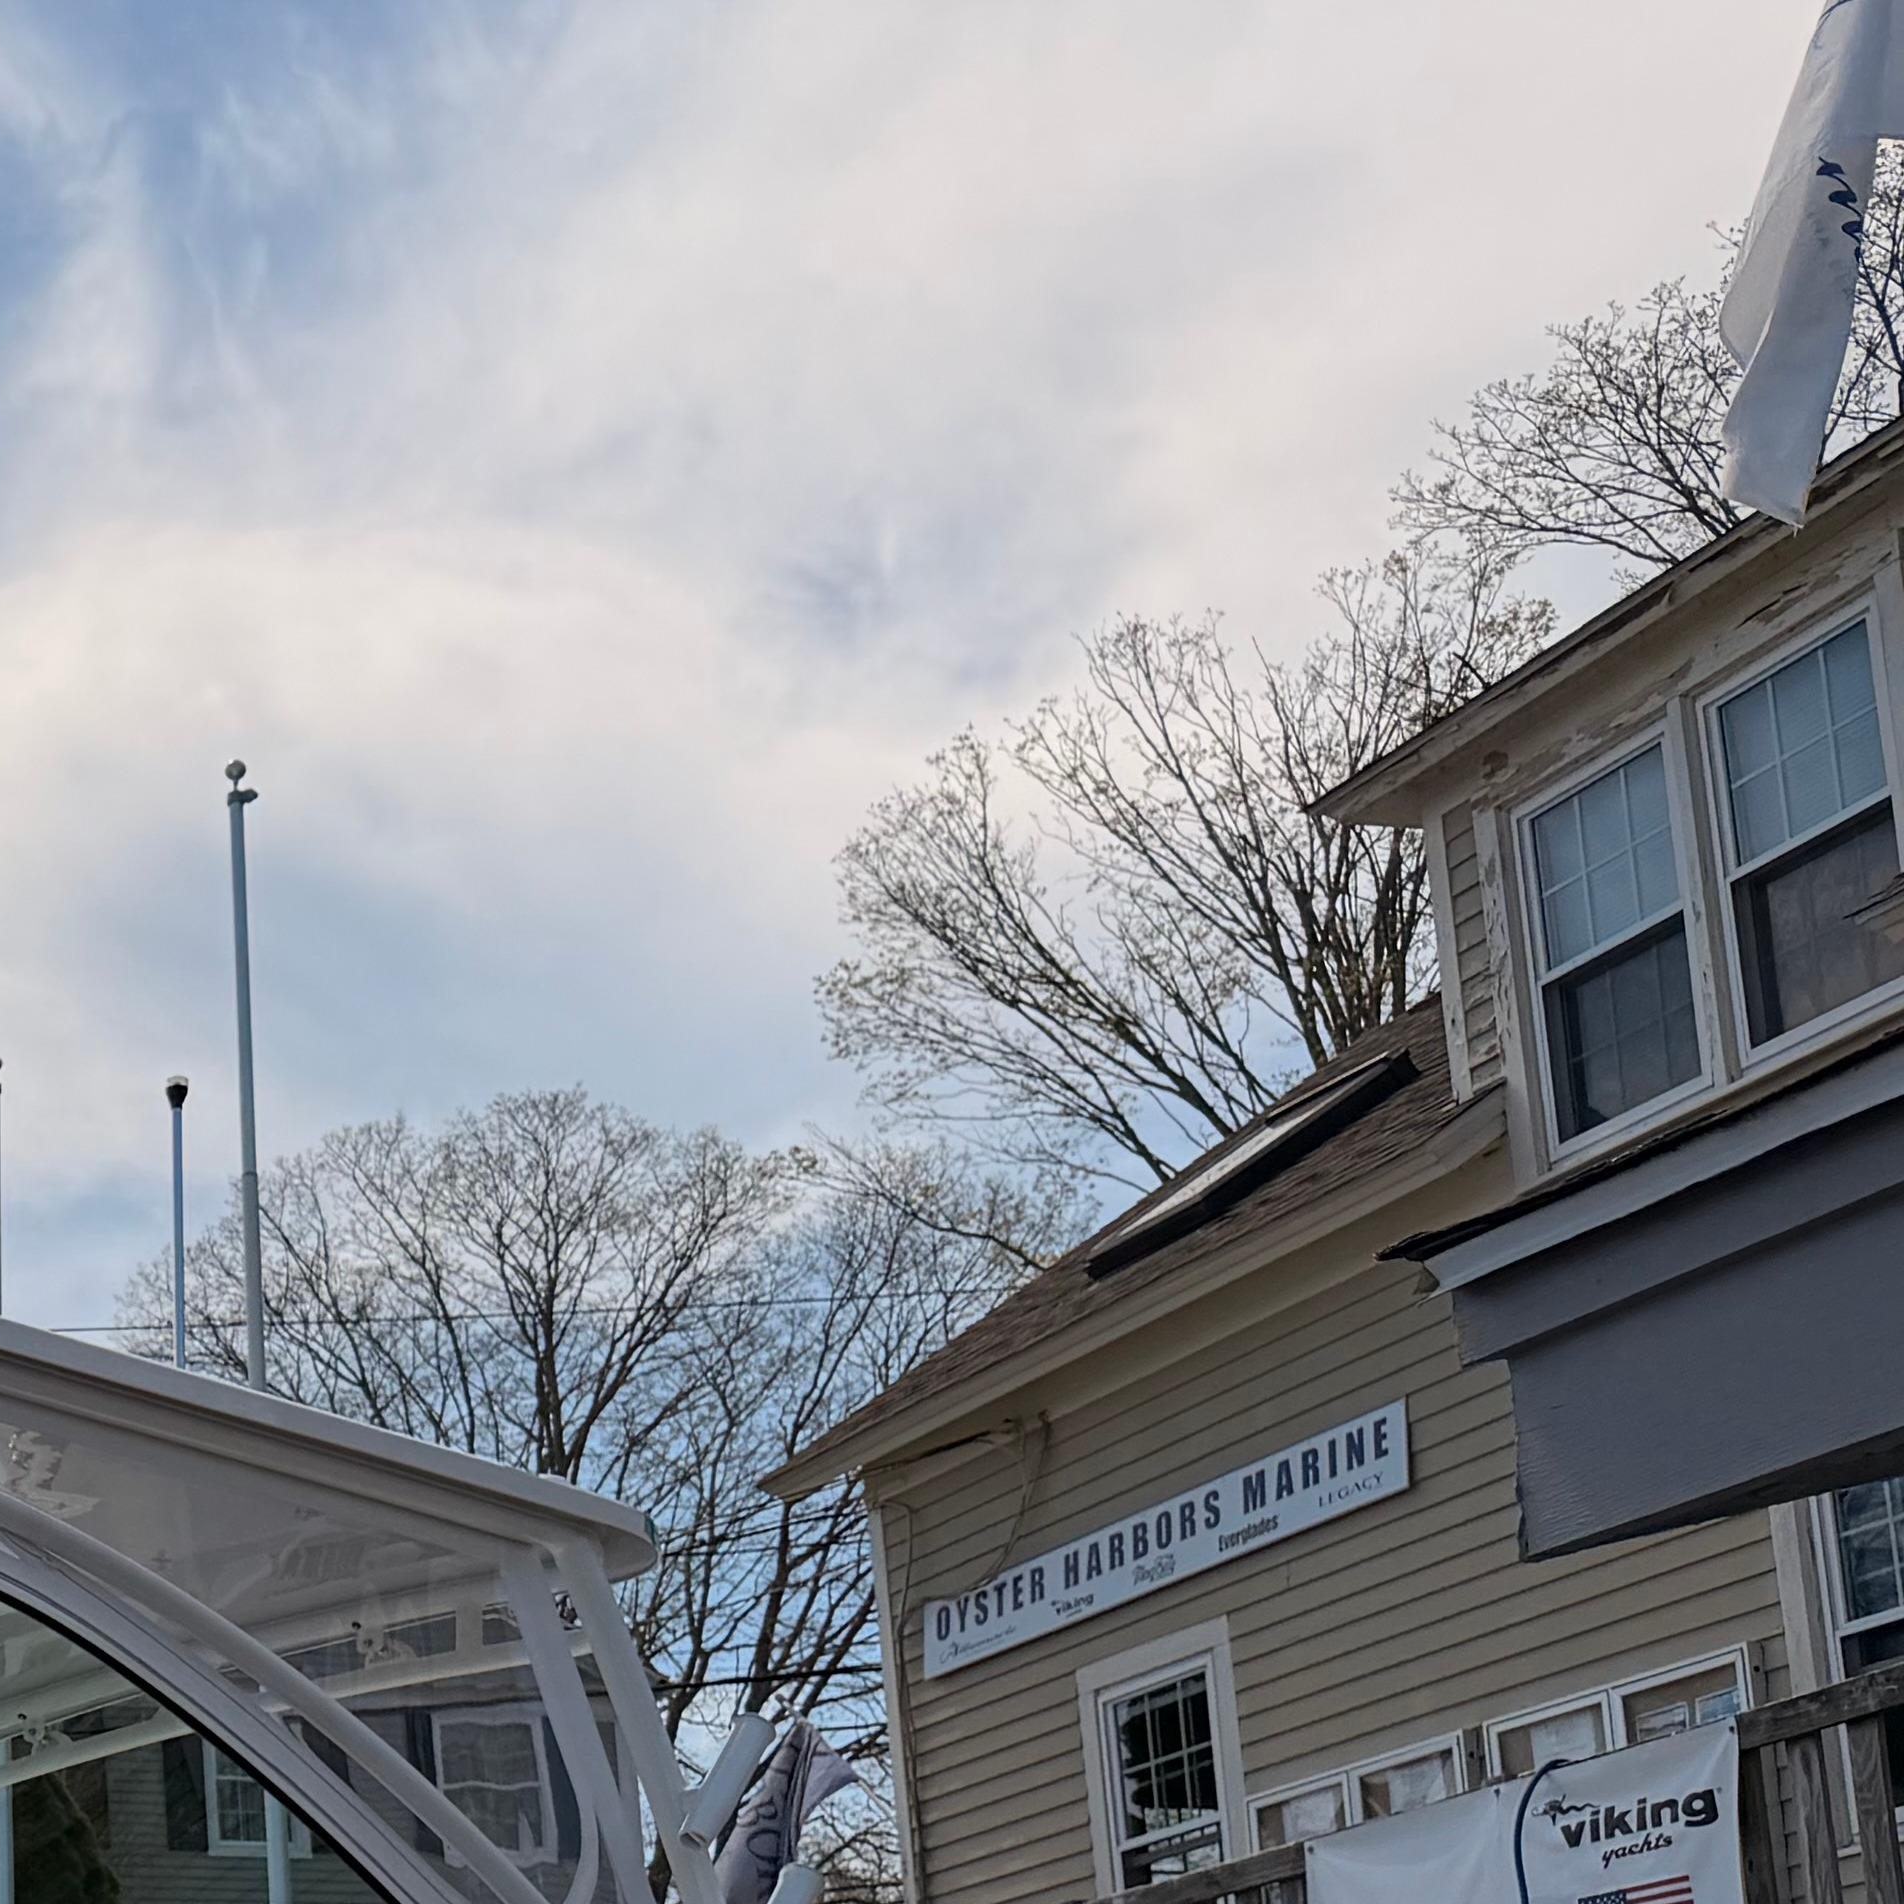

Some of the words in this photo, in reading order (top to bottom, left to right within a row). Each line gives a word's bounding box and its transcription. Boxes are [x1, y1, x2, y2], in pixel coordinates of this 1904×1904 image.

[1318, 1471, 1384, 1508] LEGACY
[936, 1565, 1045, 1641] OYSTER
[1063, 1489, 1221, 1591] HARBORS
[1242, 1416, 1389, 1515] MARINE
[1218, 1513, 1280, 1552] Everglades
[1560, 1788, 1719, 1849] viking
[1602, 1833, 1673, 1869] yachts
